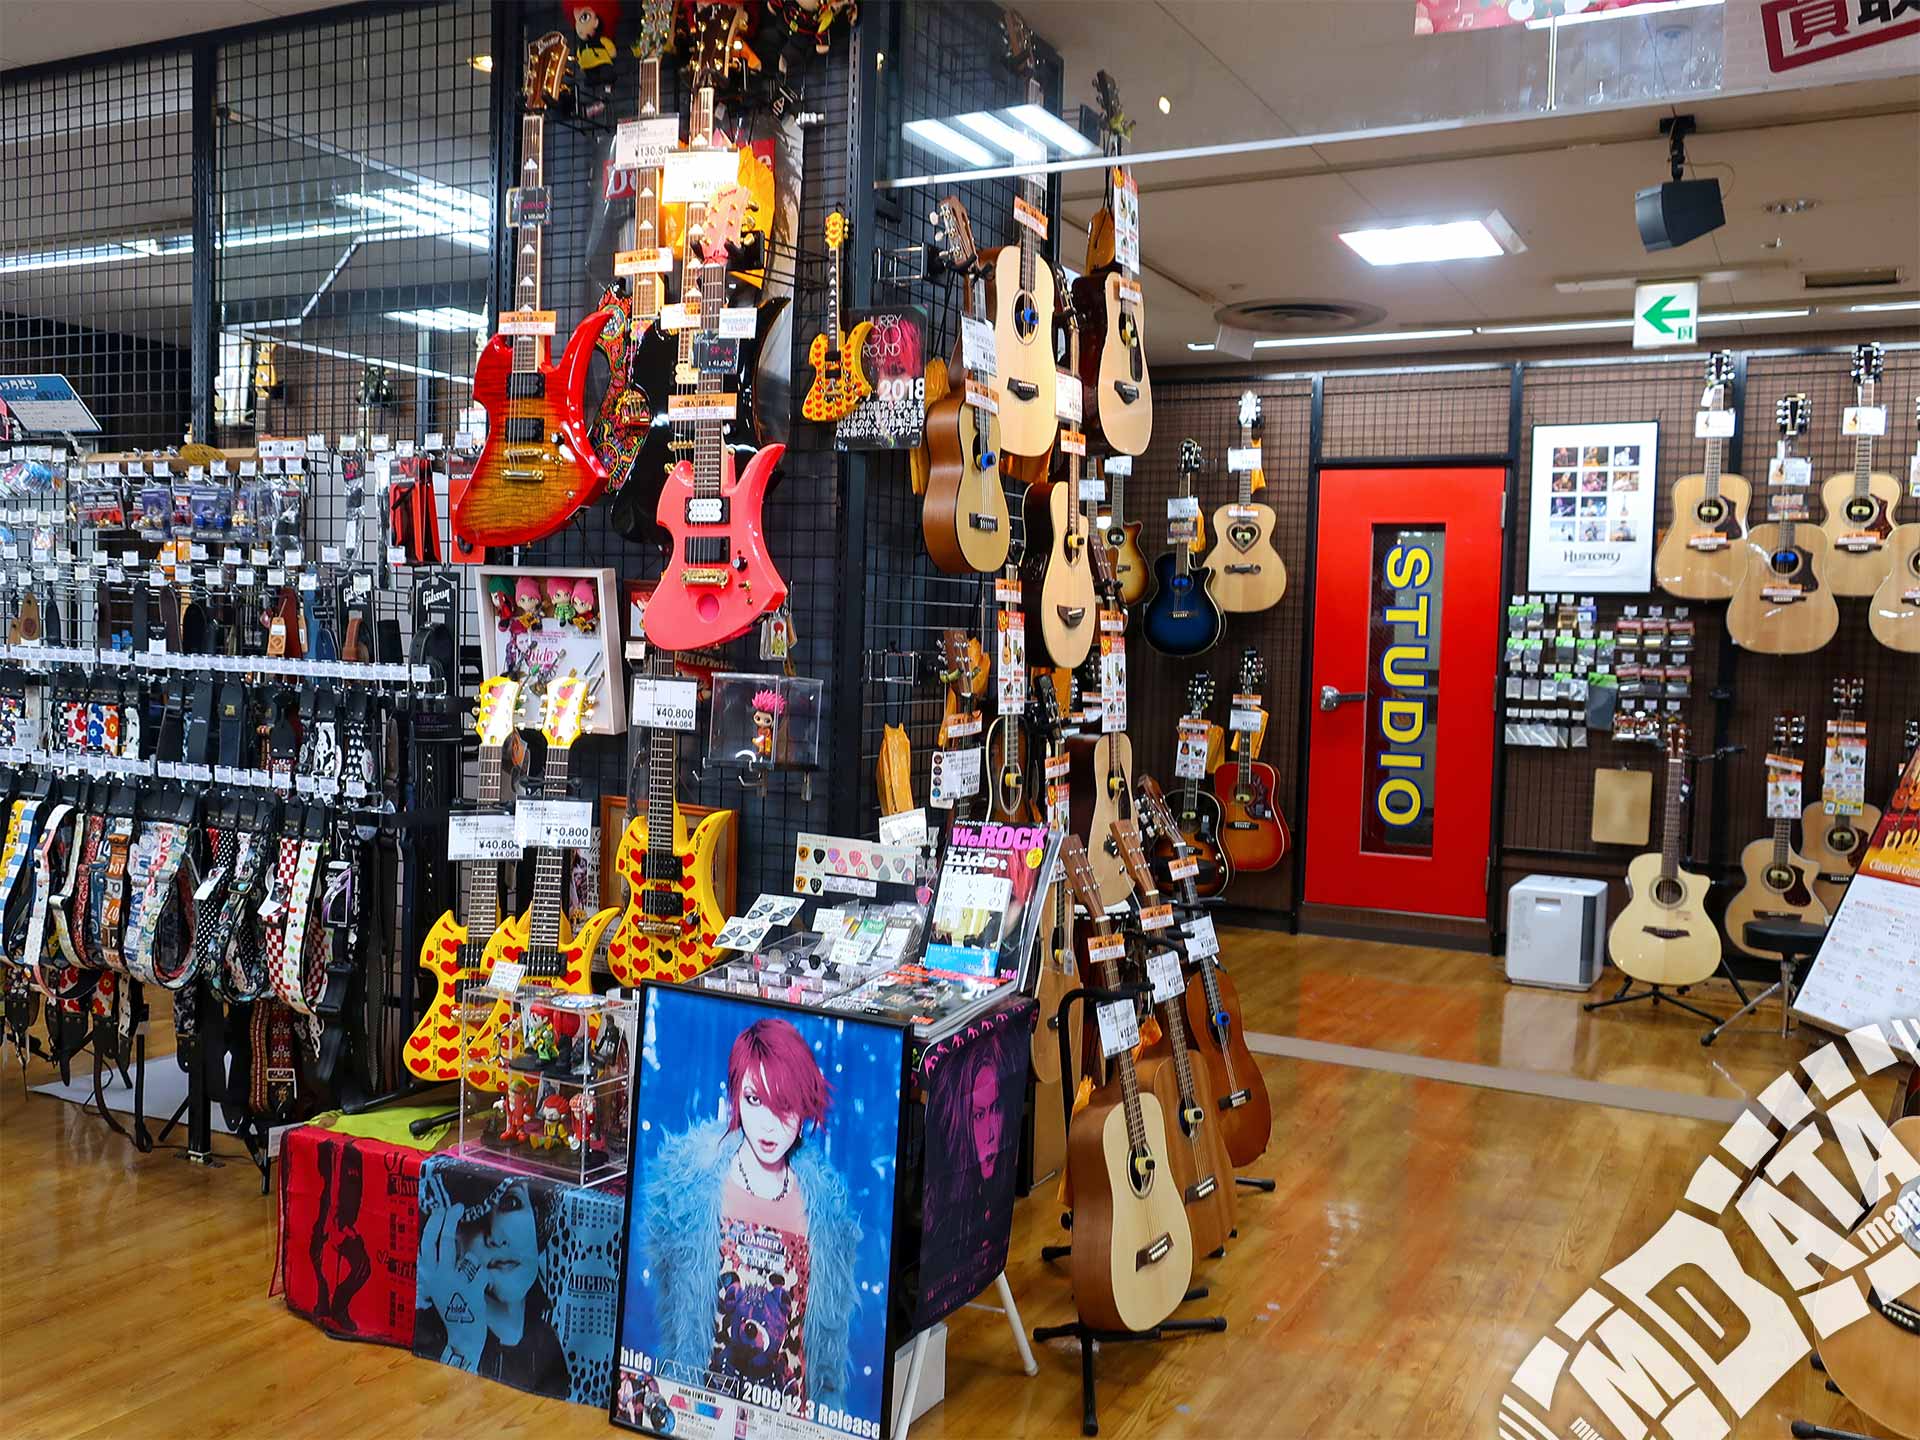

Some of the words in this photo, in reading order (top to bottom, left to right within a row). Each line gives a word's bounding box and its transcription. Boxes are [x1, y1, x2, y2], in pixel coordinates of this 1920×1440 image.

[862, 343, 901, 358] ROUND
[879, 378, 925, 401] 2018
[422, 588, 451, 611] Gibson
[1374, 546, 1435, 828] STUDIO
[479, 840, 520, 850] ¥40,80
[568, 1272, 617, 1293] AUGUST
[620, 1346, 653, 1373] hide
[817, 1403, 880, 1440] Release
